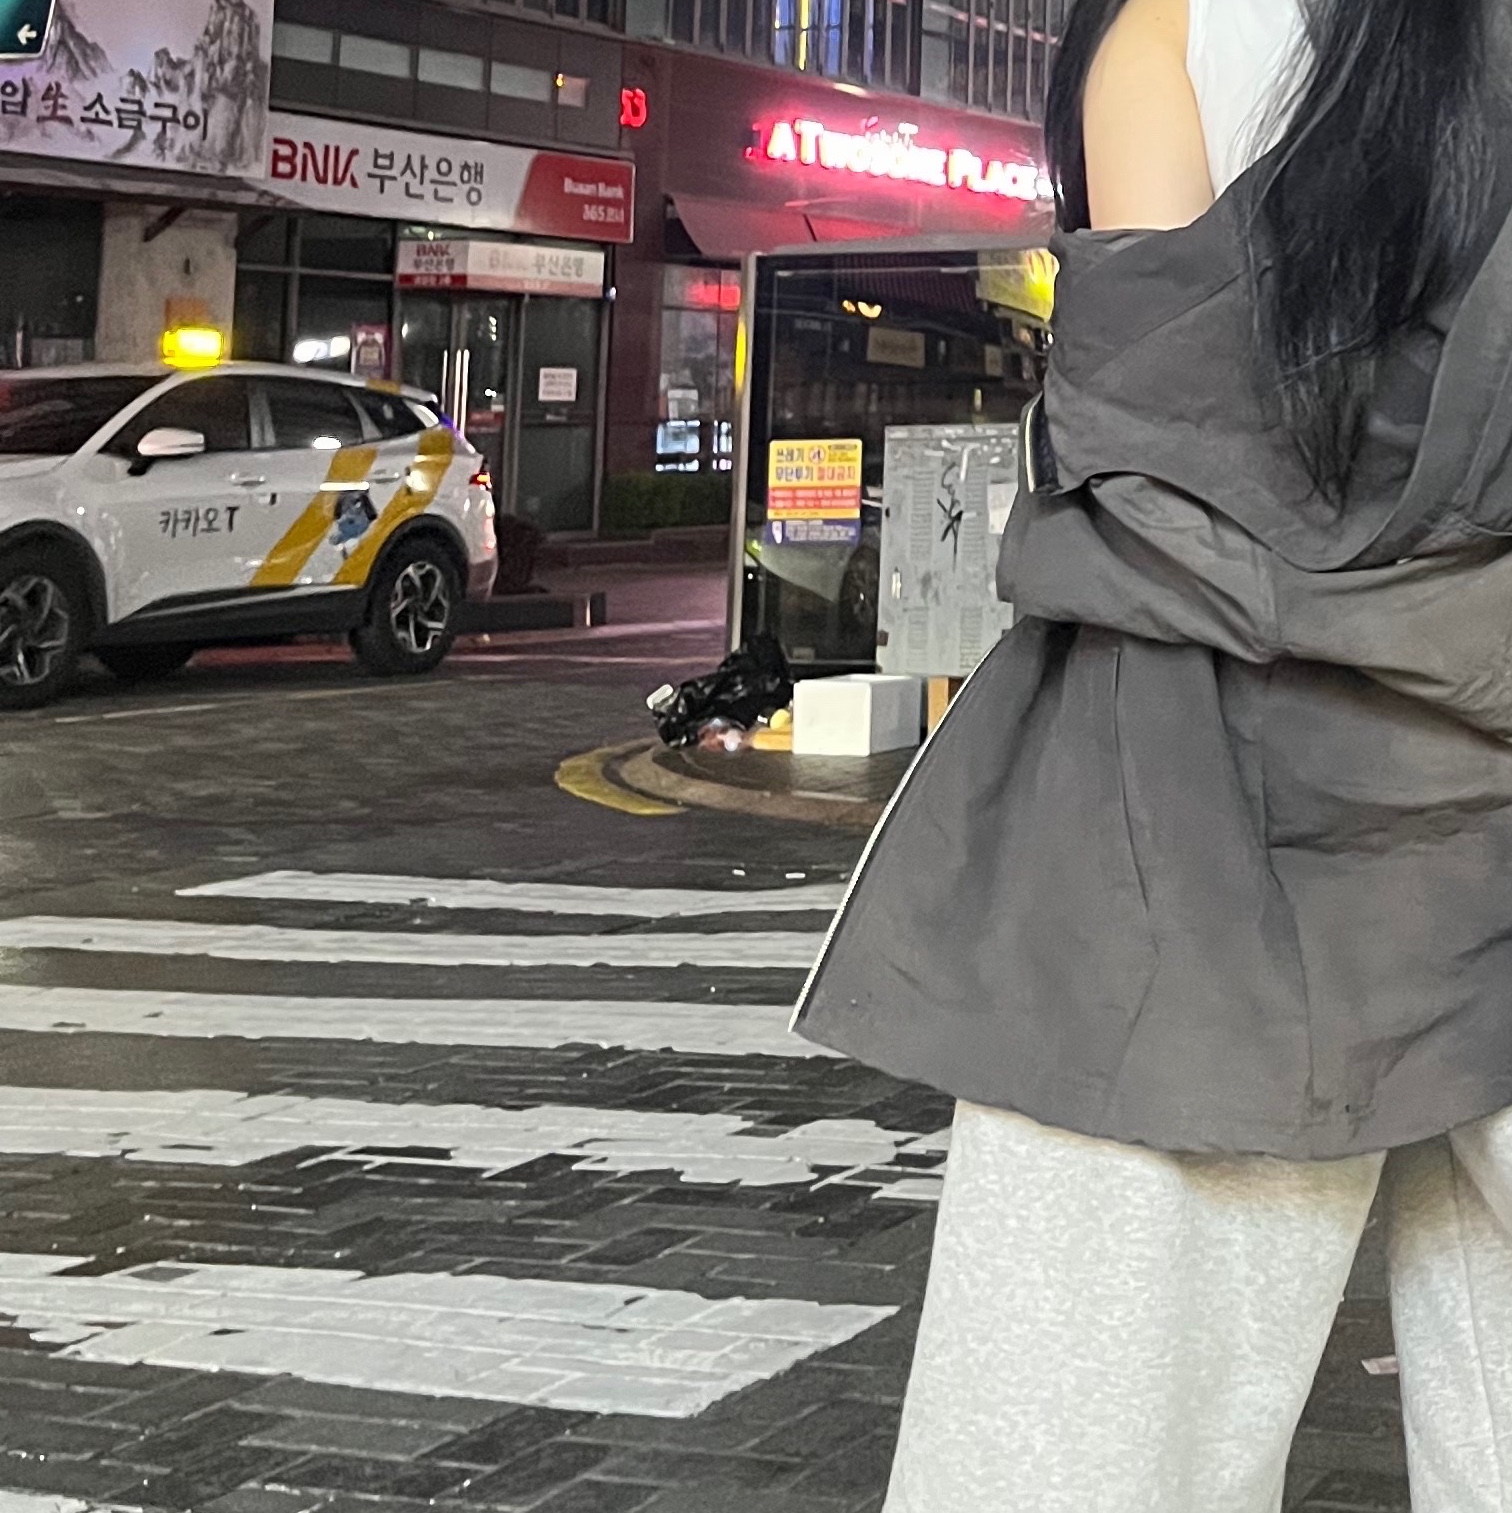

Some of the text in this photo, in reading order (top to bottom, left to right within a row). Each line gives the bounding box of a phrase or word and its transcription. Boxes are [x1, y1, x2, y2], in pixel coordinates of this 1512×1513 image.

[80, 92, 209, 140] 소금구이
[271, 137, 484, 207] BNK 부산은행
